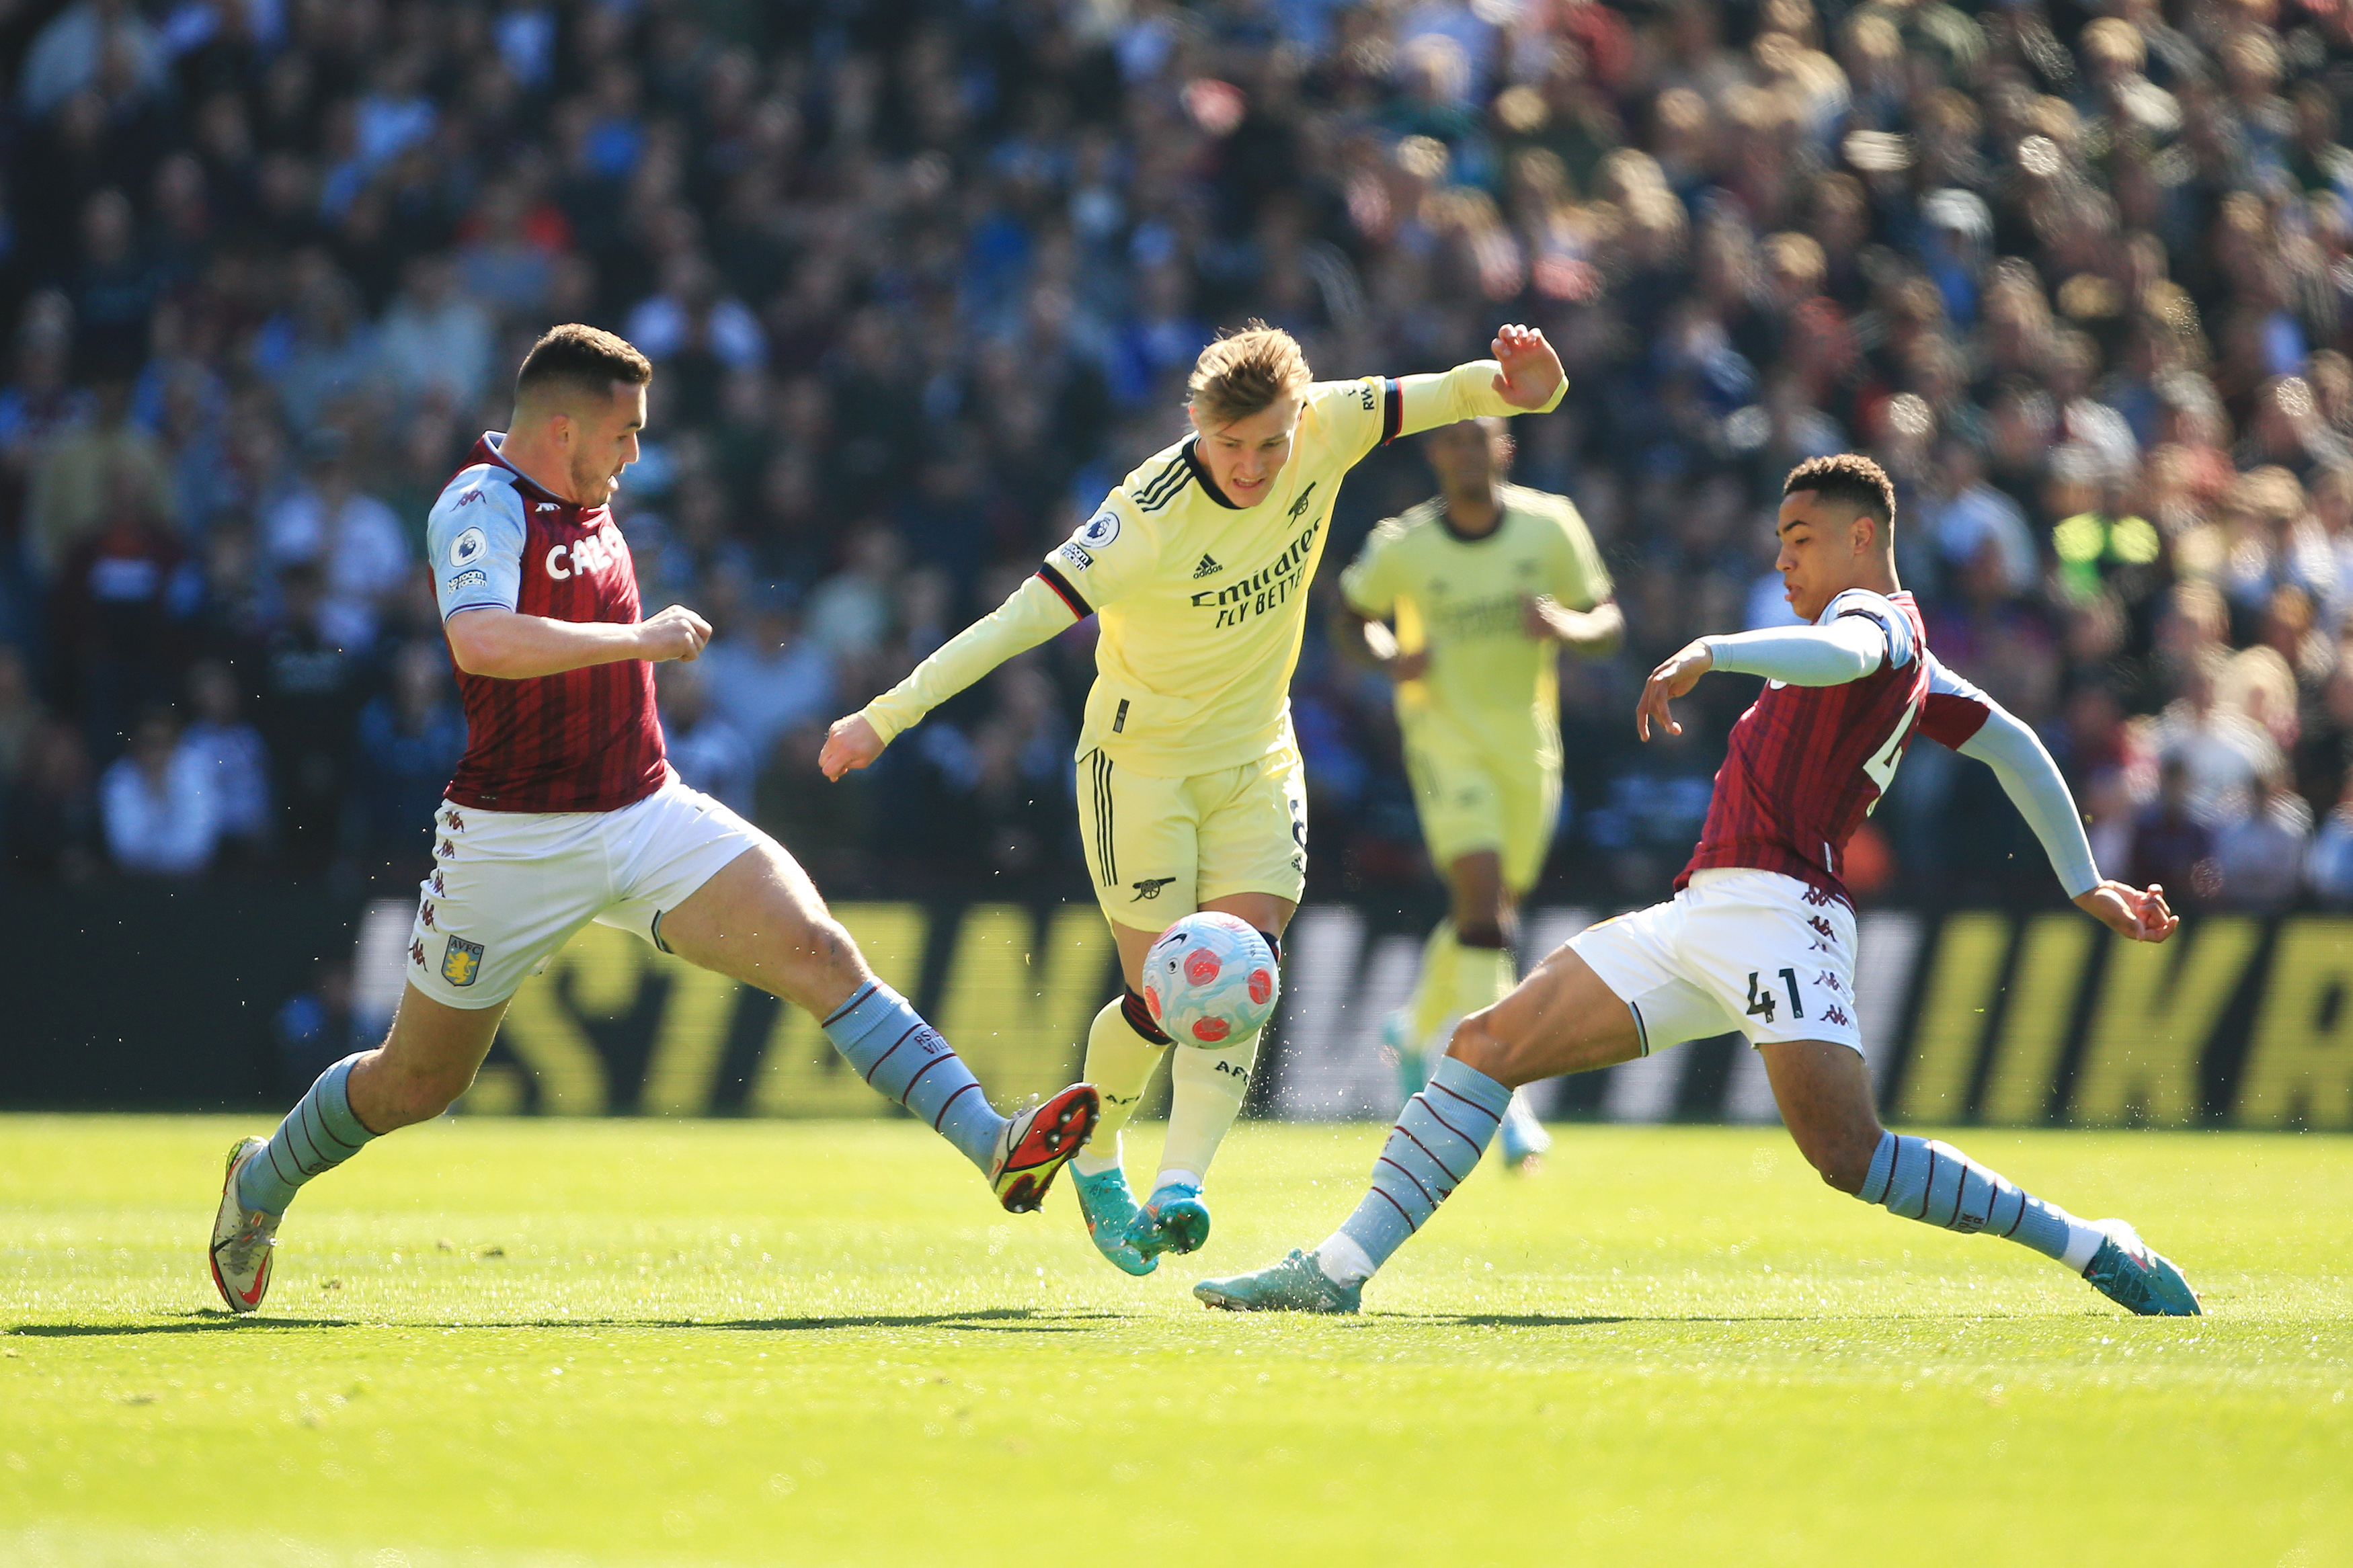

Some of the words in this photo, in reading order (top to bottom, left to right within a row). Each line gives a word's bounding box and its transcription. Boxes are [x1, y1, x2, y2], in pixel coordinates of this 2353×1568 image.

[447, 577, 458, 587] No
[458, 571, 484, 583] room
[1193, 564, 1223, 579] adidas
[458, 578, 487, 589] racism
[1215, 602, 1249, 628] FLY
[1256, 559, 1308, 616] BETTE
[450, 940, 481, 955] AVFC
[1746, 968, 1804, 1024] 41
